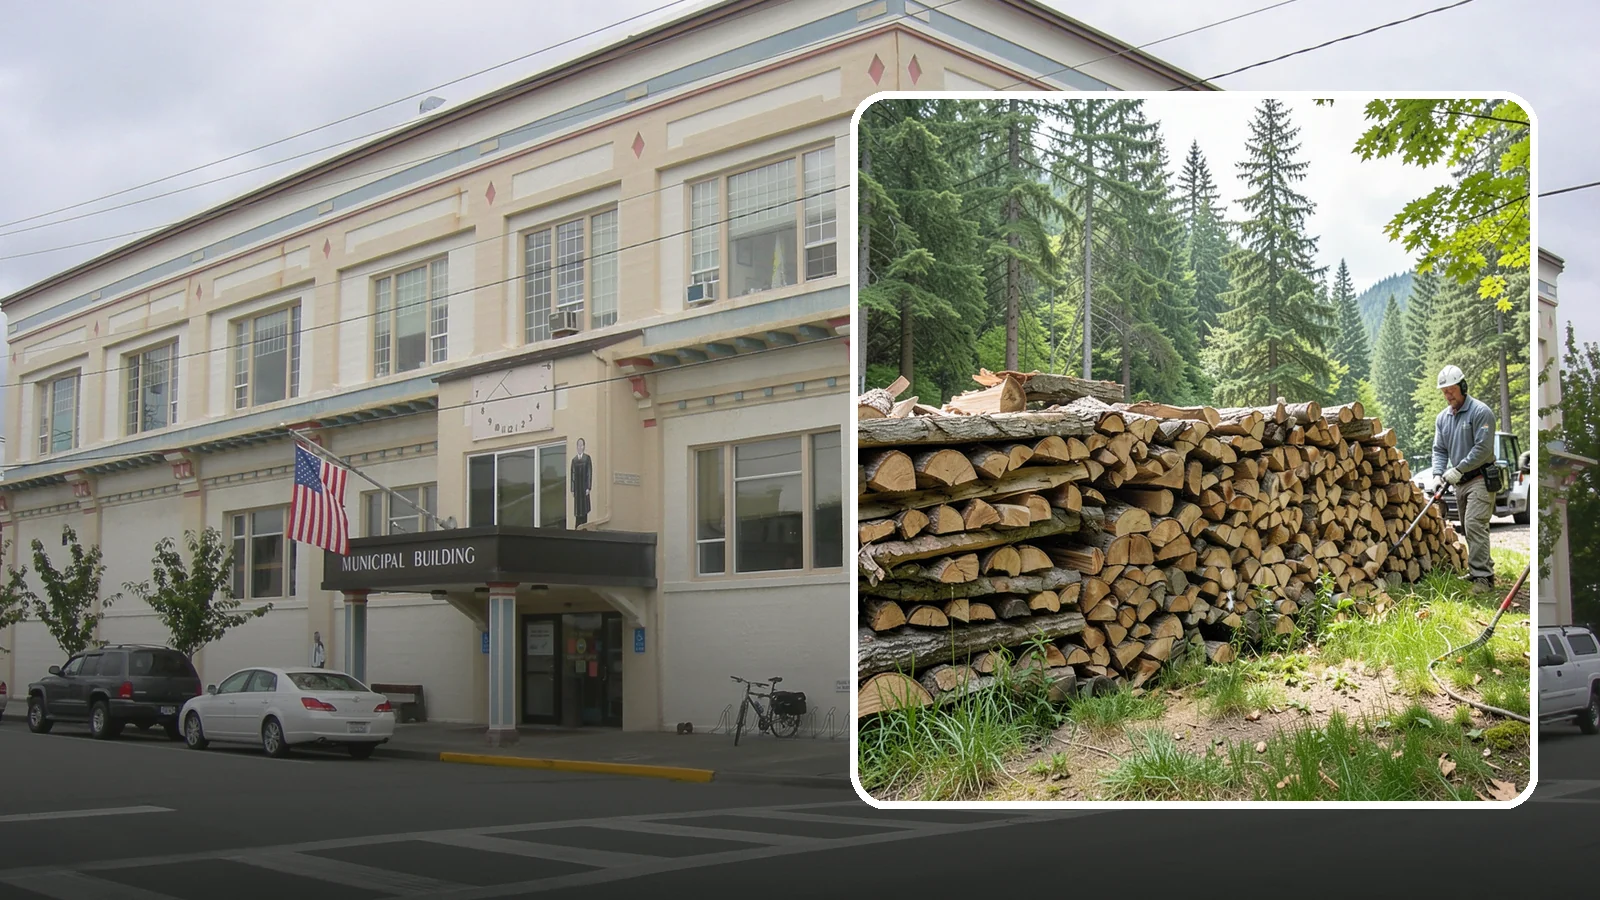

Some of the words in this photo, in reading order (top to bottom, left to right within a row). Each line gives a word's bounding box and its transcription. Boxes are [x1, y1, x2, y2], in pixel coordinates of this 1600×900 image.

[475, 390, 479, 398] 7
[536, 402, 540, 410] 4
[480, 407, 485, 415] 8
[488, 417, 492, 426] 9
[528, 414, 533, 422] 3
[494, 423, 500, 431] 10
[521, 420, 525, 428] 2
[507, 425, 513, 433] 12
[342, 552, 405, 572] MUNICIPAL
[414, 546, 475, 567] BUILDING
